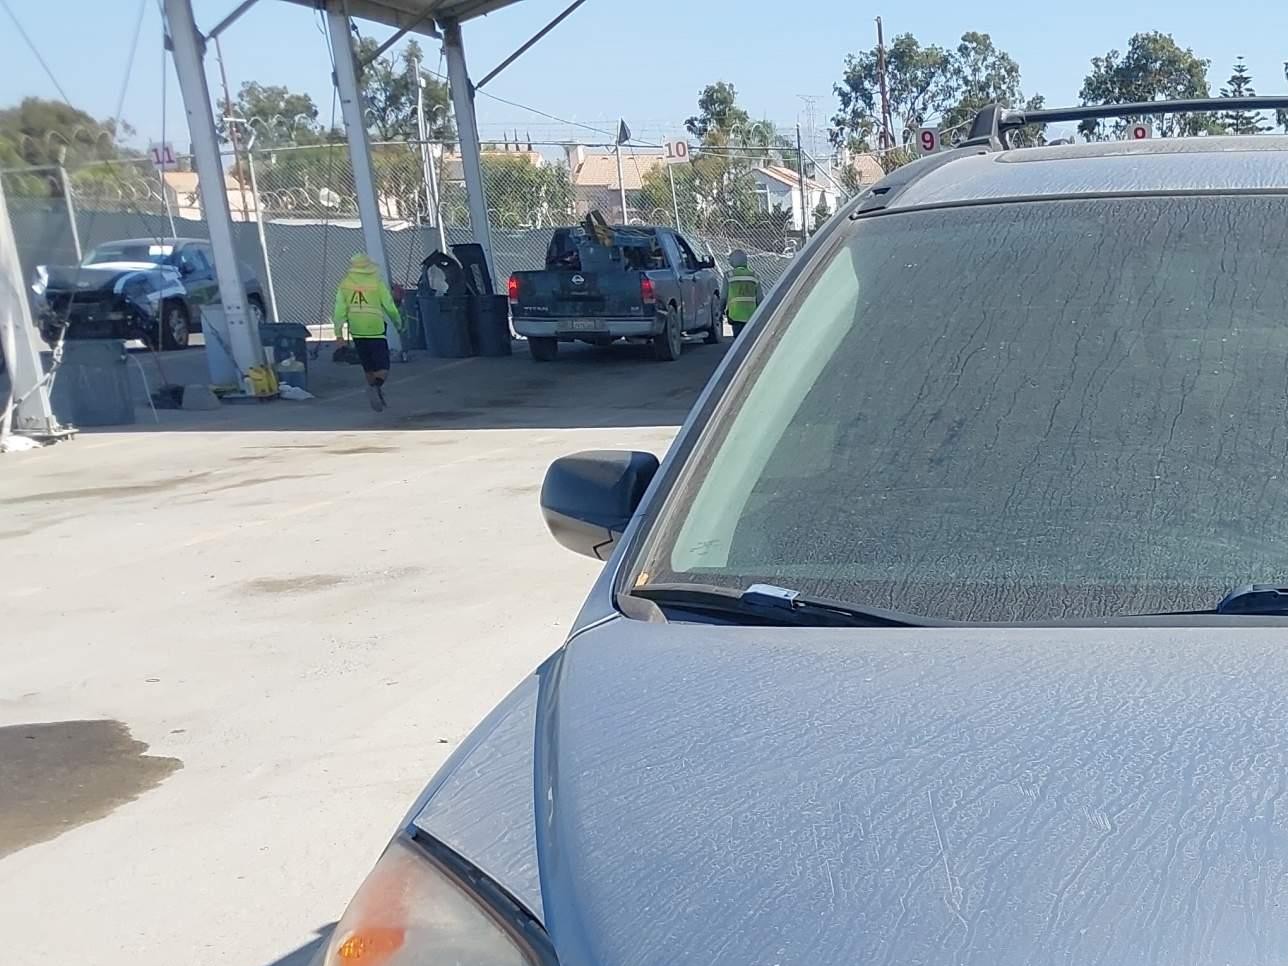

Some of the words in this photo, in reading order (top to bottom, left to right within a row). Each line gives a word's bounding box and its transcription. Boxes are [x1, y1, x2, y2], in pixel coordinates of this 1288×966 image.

[665, 141, 687, 158] 10
[922, 131, 934, 151] 9
[152, 147, 176, 165] 11
